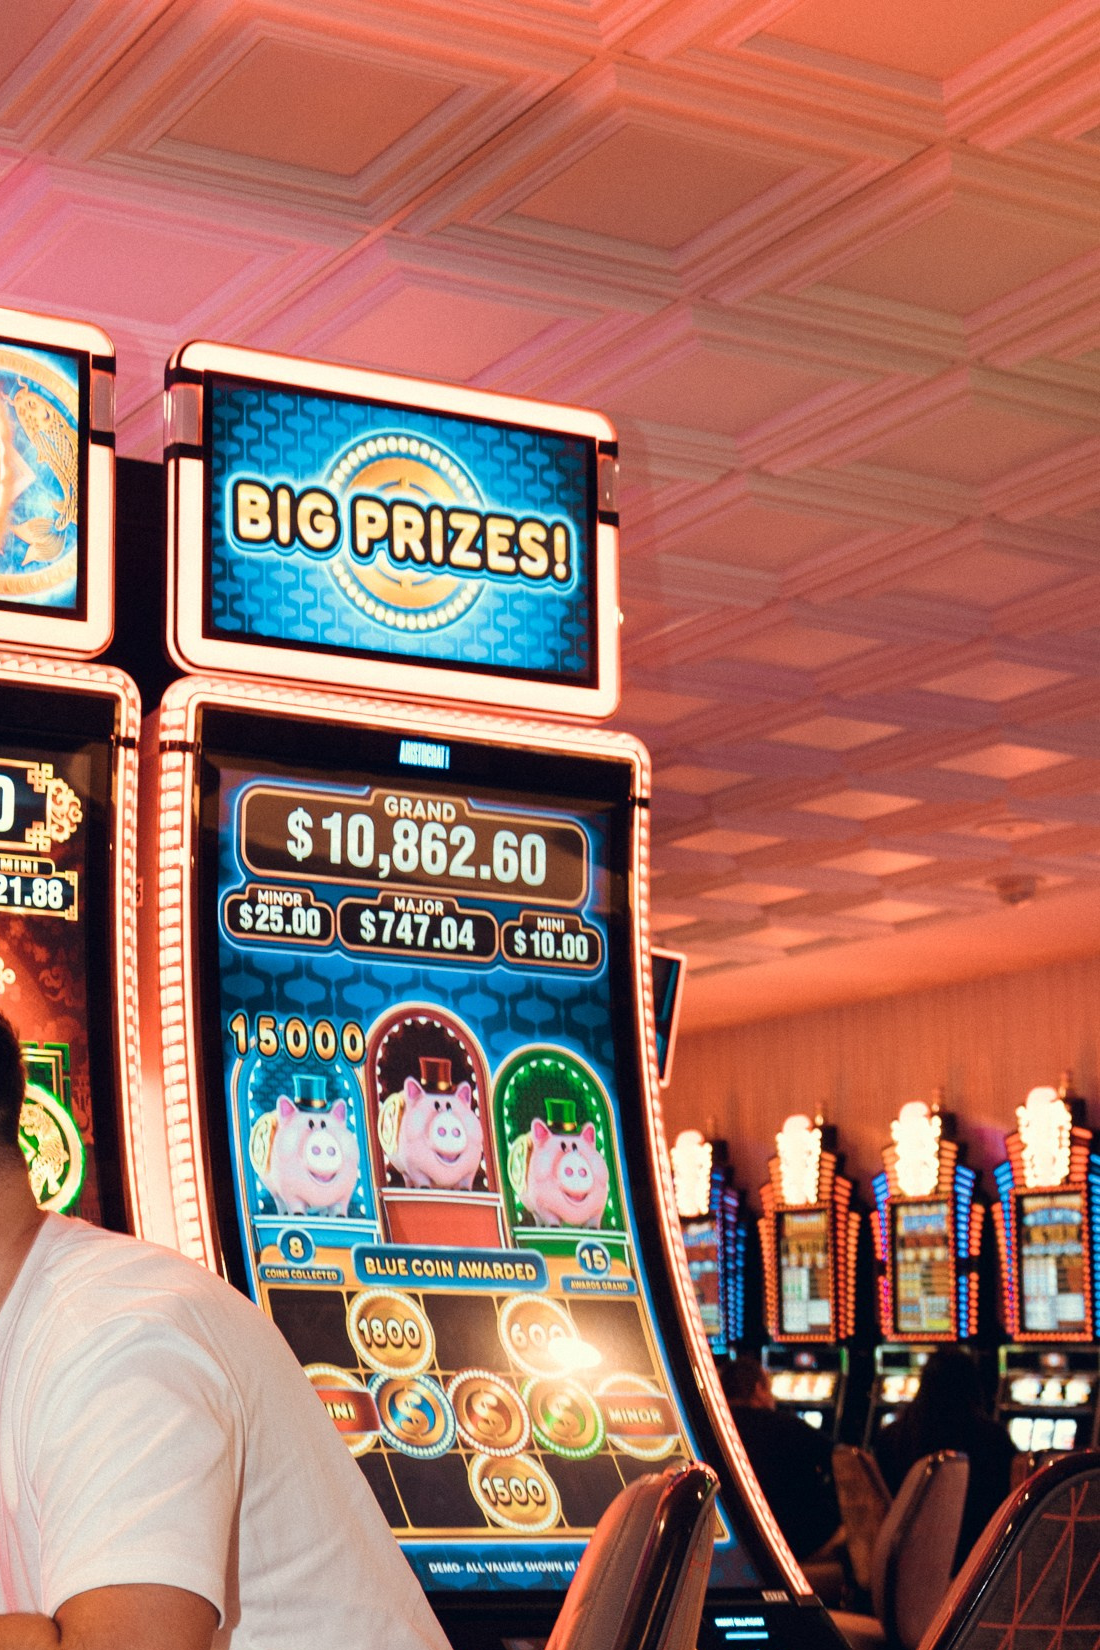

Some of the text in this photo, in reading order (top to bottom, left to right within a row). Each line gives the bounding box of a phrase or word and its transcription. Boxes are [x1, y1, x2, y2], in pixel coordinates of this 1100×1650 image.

[235, 480, 569, 582] BIG PRIZES!
[384, 796, 456, 823] GRAND
[286, 807, 546, 886] $10,862.60
[0, 858, 39, 874] MINI
[257, 889, 303, 907] MINOR
[393, 896, 445, 916] MAJOR
[239, 901, 321, 936] $25.00
[360, 909, 475, 951] $747.04
[536, 917, 565, 933] MINI
[514, 929, 589, 962] $10.00
[230, 1013, 366, 1062] 15000
[288, 1236, 305, 1259] 8
[581, 1249, 607, 1270] 15
[265, 1268, 338, 1281] COINS COLLECTED
[364, 1257, 537, 1281] BLUE COIN AWARDED
[358, 1317, 420, 1349] 1800
[608, 1407, 662, 1425] MINOR
[482, 1476, 544, 1506] 1500
[466, 1562, 485, 1573] ALL
[485, 1562, 524, 1573] VALUES
[524, 1561, 563, 1573] SHOWN
